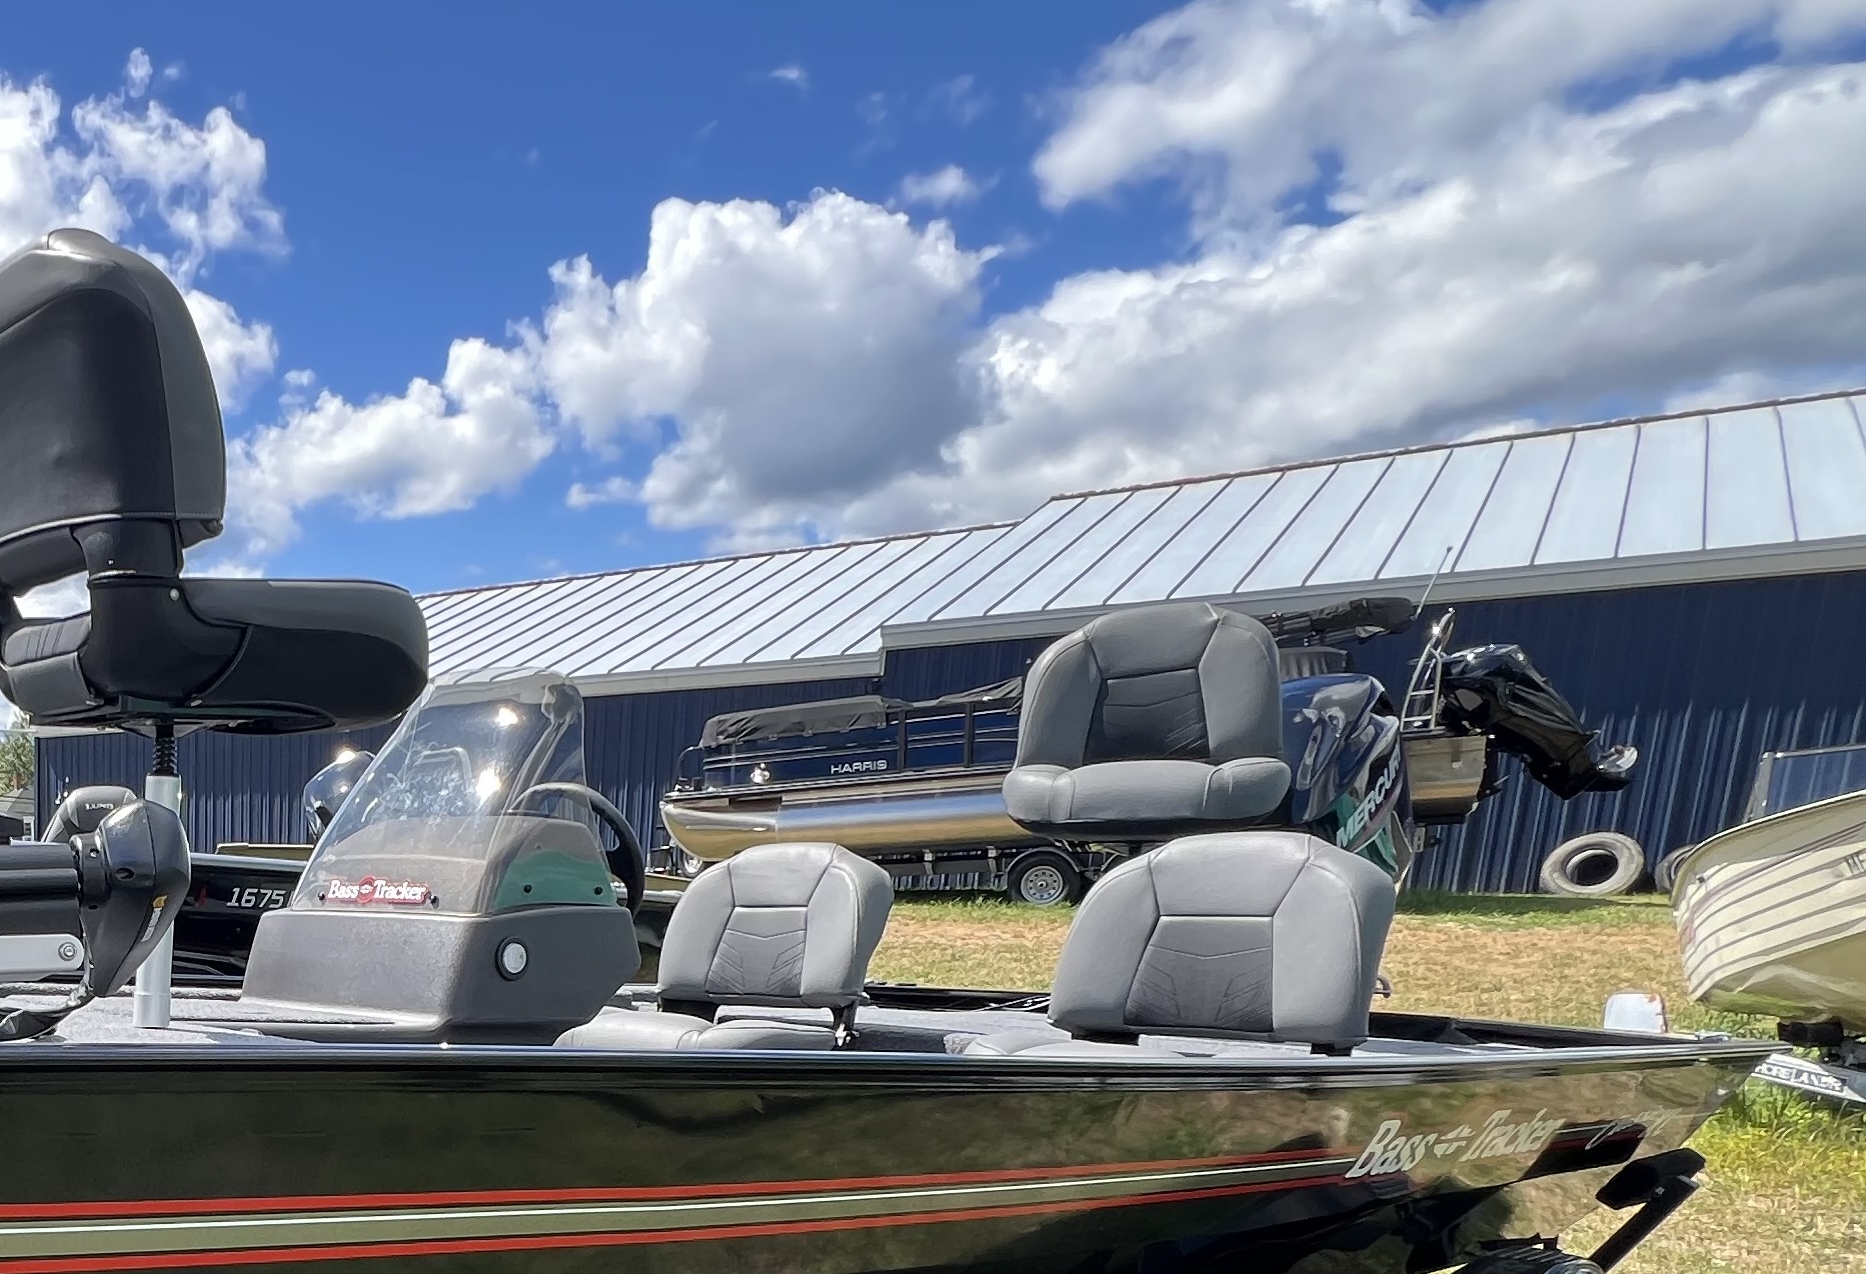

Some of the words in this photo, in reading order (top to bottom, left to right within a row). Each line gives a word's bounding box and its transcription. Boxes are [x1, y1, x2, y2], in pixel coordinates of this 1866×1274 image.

[831, 760, 888, 775] HARRIS
[226, 887, 287, 909] 1675
[328, 879, 360, 899] Bass
[371, 880, 427, 901] Tracker
[1345, 1119, 1439, 1179] Bass
[1459, 1107, 1567, 1162] Tracker
